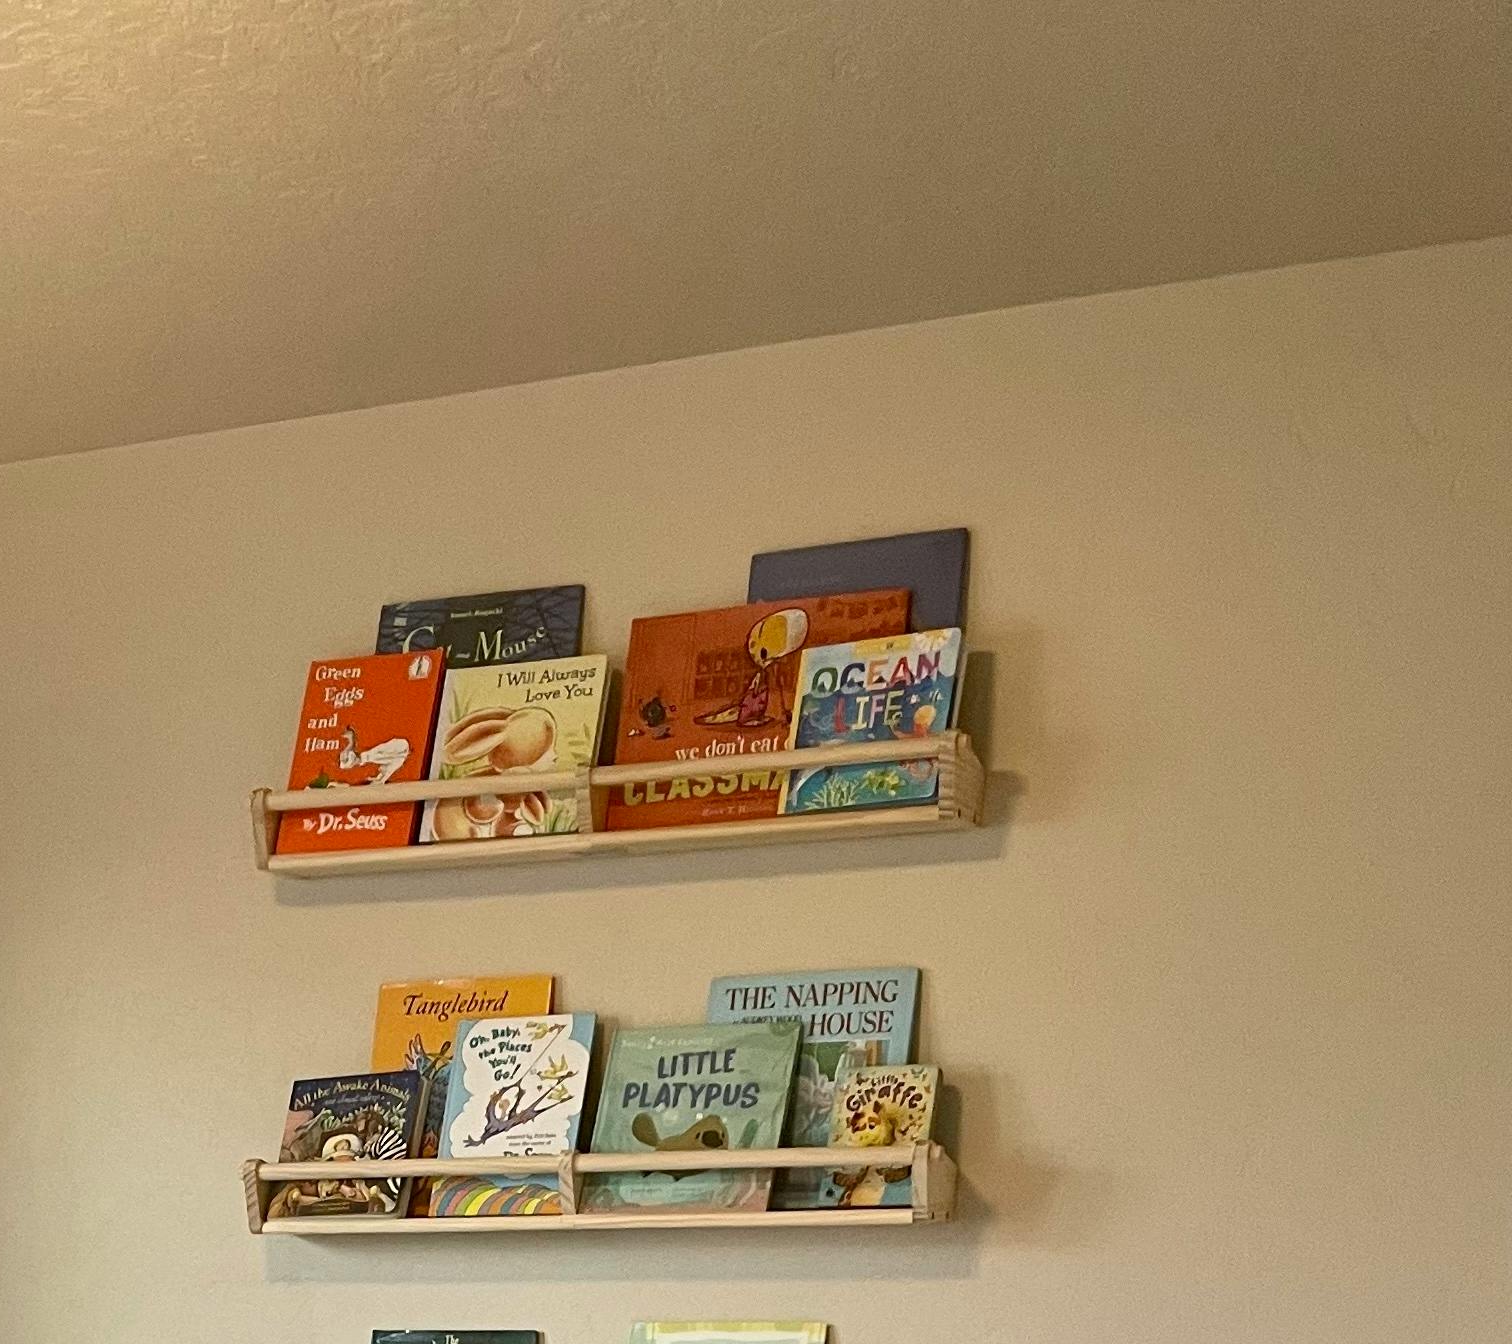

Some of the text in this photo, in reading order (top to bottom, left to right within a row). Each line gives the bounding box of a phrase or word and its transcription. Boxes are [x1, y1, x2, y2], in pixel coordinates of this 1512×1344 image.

[316, 665, 361, 681] Green
[507, 670, 535, 686] Will
[539, 667, 597, 684] Always
[811, 650, 941, 697] OCEAN
[324, 686, 364, 709] Eggs
[526, 683, 594, 703] Love You
[307, 714, 338, 729] and
[834, 690, 904, 733] LIFE
[304, 736, 340, 753] Ham
[705, 735, 745, 758] don't
[345, 808, 388, 831] Seuss
[403, 990, 510, 1023] Tanglebird
[725, 979, 899, 1011] THE NAPPING
[806, 1010, 895, 1038] HOUSE
[498, 1040, 532, 1053] Places
[658, 1048, 736, 1079] LITTLE
[622, 1082, 760, 1109] PLATYPUS
[846, 1081, 923, 1112] Giraffe
